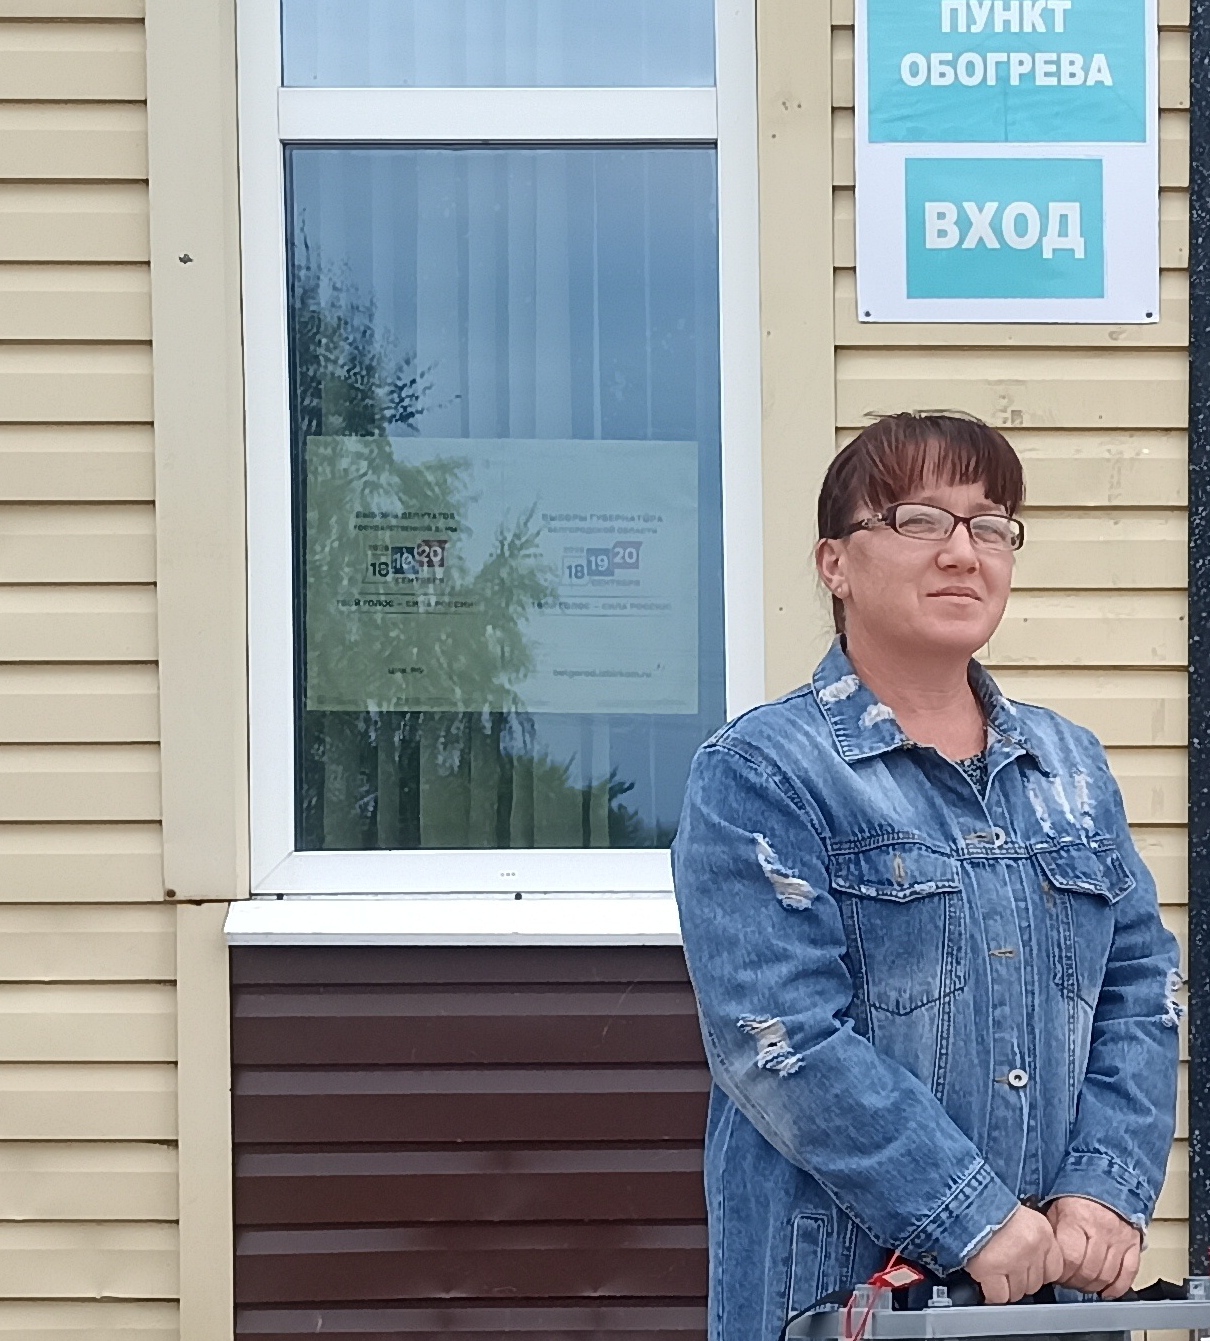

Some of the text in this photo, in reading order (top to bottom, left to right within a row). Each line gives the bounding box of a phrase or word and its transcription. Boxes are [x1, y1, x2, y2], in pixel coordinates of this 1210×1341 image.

[941, 0, 1072, 33] ПУНКТ
[900, 52, 1114, 87] ОБОГРЕВА
[924, 201, 1085, 259] ВХОД
[369, 561, 391, 577] 18
[418, 545, 443, 562] 20
[566, 547, 638, 580] 18 19 20
